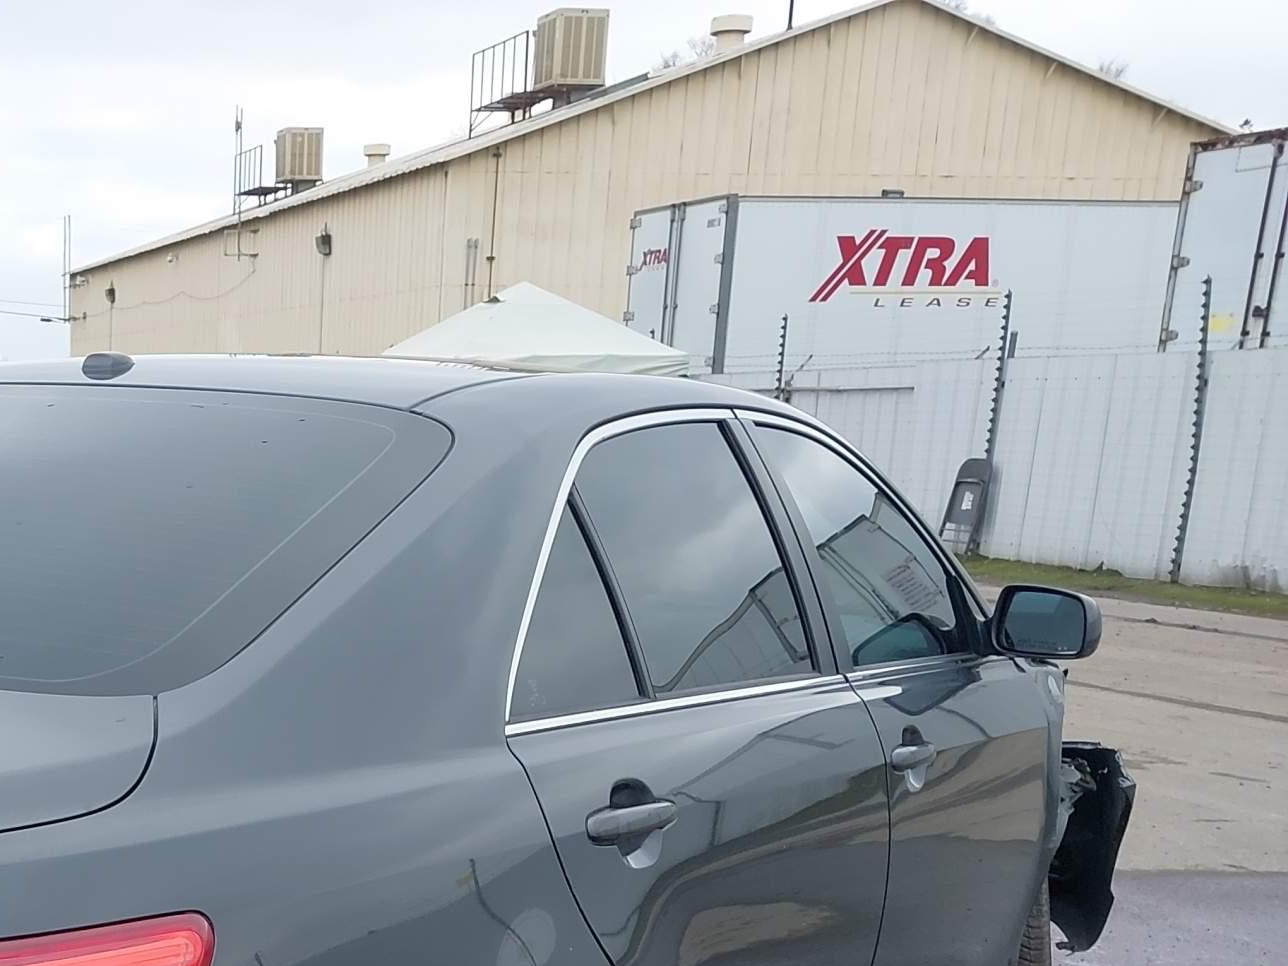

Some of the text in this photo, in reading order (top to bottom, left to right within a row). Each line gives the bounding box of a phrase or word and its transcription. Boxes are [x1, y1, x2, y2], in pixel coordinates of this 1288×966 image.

[637, 247, 669, 271] XTRA
[808, 229, 990, 302] XTRA
[873, 297, 1000, 308] LEASE
